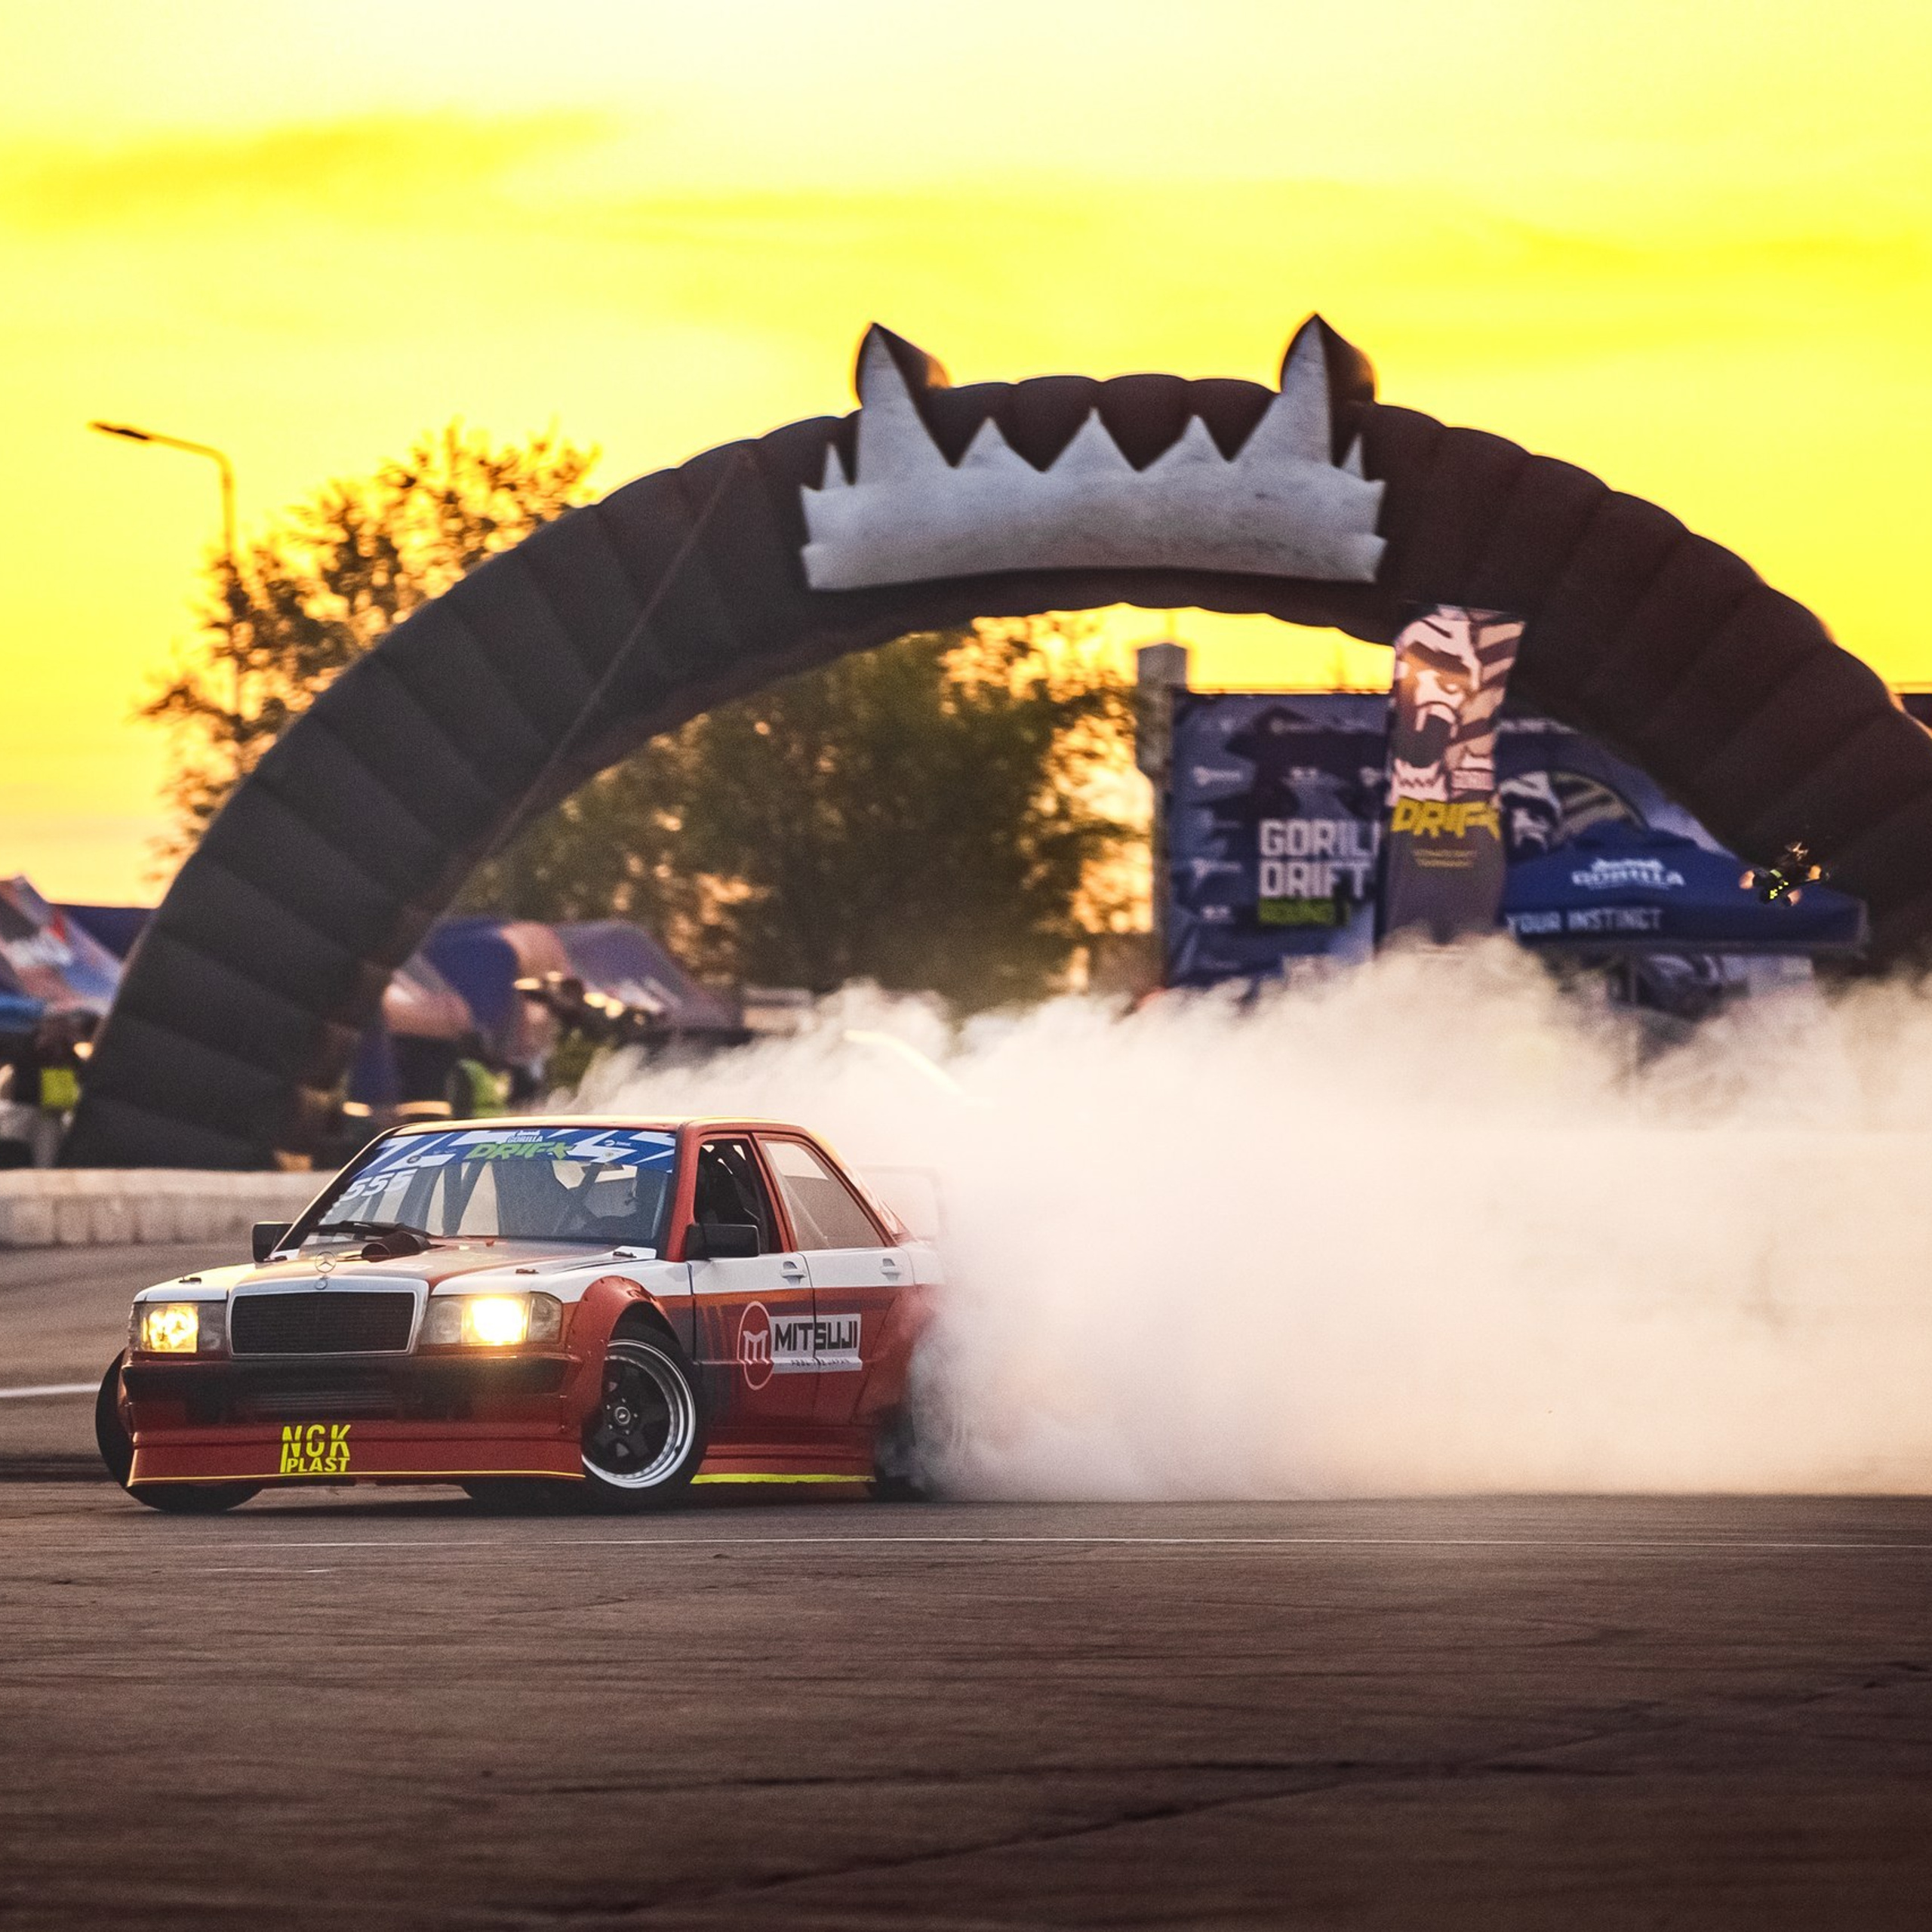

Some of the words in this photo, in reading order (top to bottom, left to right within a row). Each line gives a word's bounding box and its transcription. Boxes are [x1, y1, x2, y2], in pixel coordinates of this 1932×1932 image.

[1260, 861, 1371, 898] DRIFT
[774, 1321, 857, 1351] MITSUJI
[286, 1457, 350, 1473] PLAST
